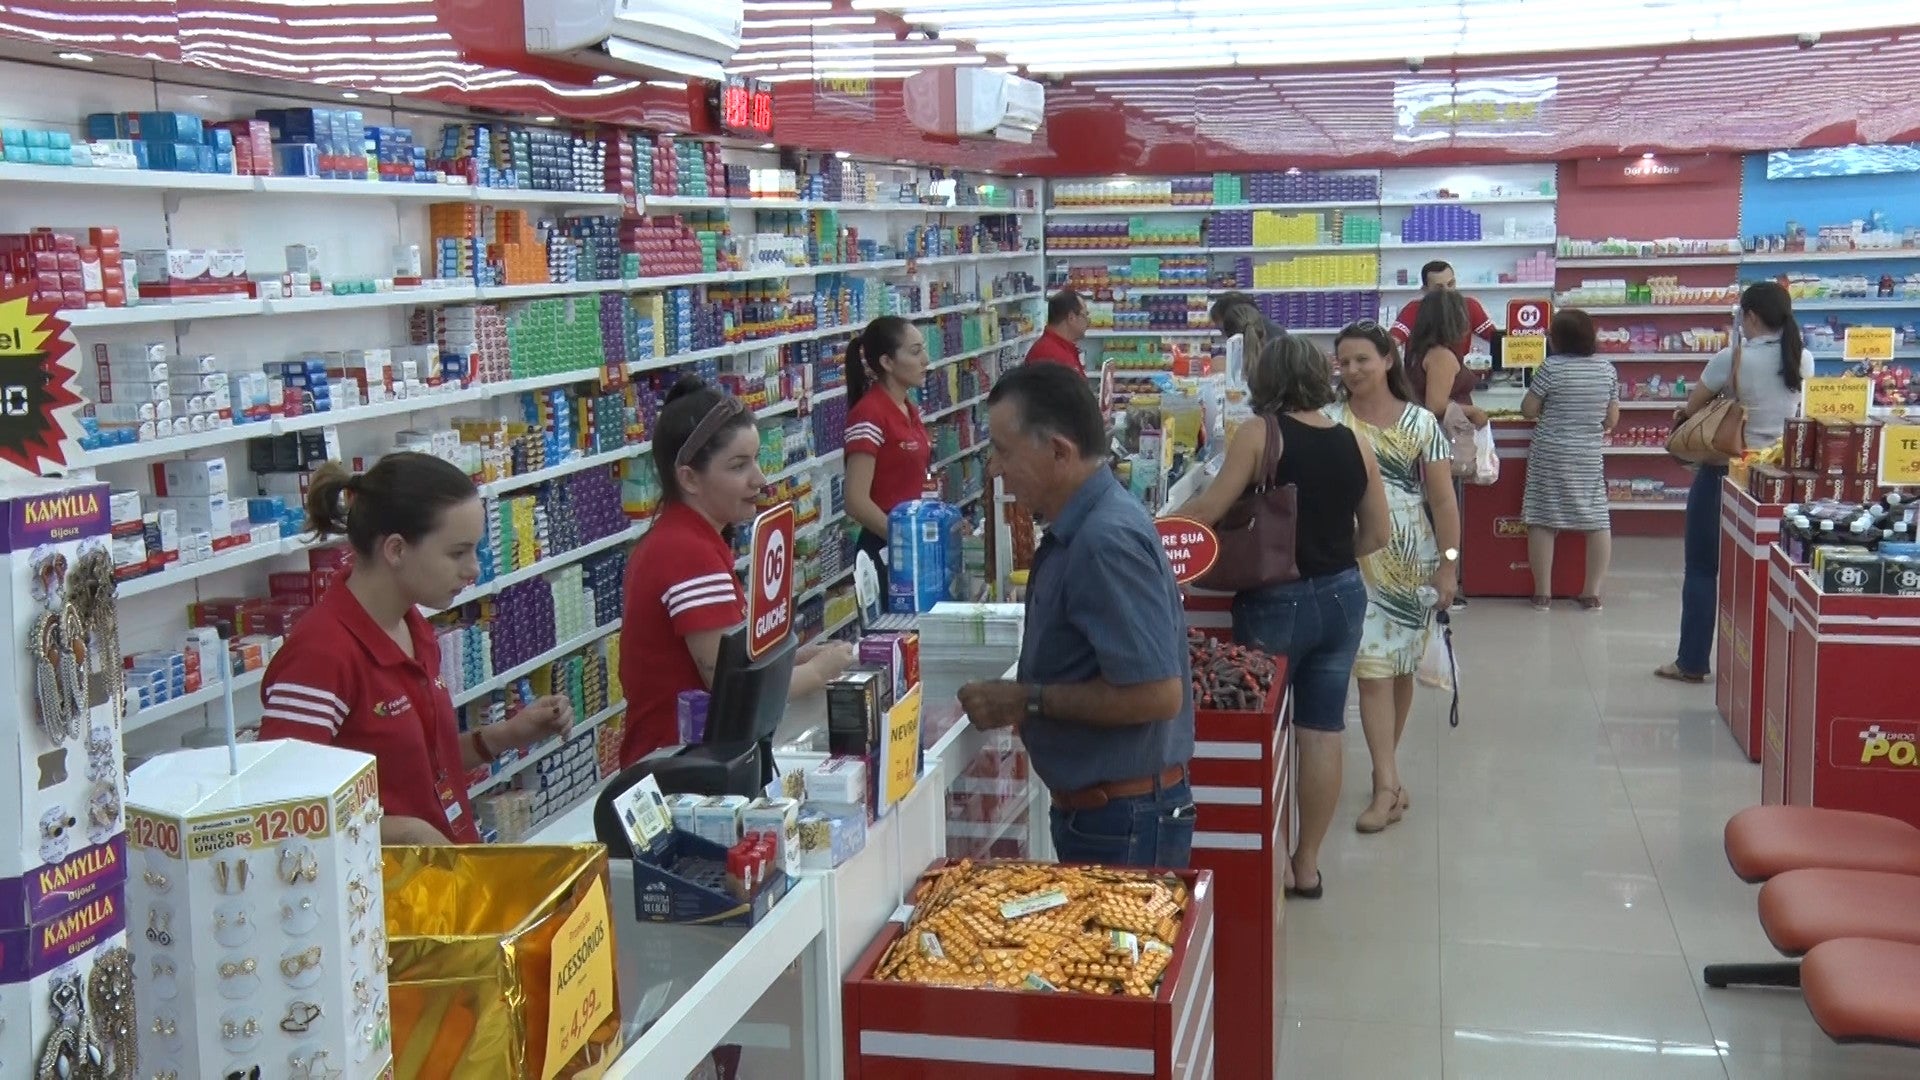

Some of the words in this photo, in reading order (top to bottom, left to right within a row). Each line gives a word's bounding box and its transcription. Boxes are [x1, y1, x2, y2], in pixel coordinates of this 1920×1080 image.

[1521, 309, 1538, 321] 01
[1822, 403, 1855, 414] 34,99
[25, 493, 98, 524] KAMYLLA
[50, 527, 80, 538] Bijoux
[1180, 532, 1204, 544] SUA
[764, 545, 784, 586] 06
[1165, 549, 1191, 560] NHA
[1173, 563, 1186, 574] UI
[134, 817, 178, 852] 12.00
[236, 831, 252, 846] R$
[255, 804, 326, 842] 12.00
[40, 844, 116, 894] KAMYLLA
[44, 895, 114, 949] KAMYLLA
[556, 919, 605, 996] ACESSÓRIOS
[570, 988, 596, 1039] 4,99
